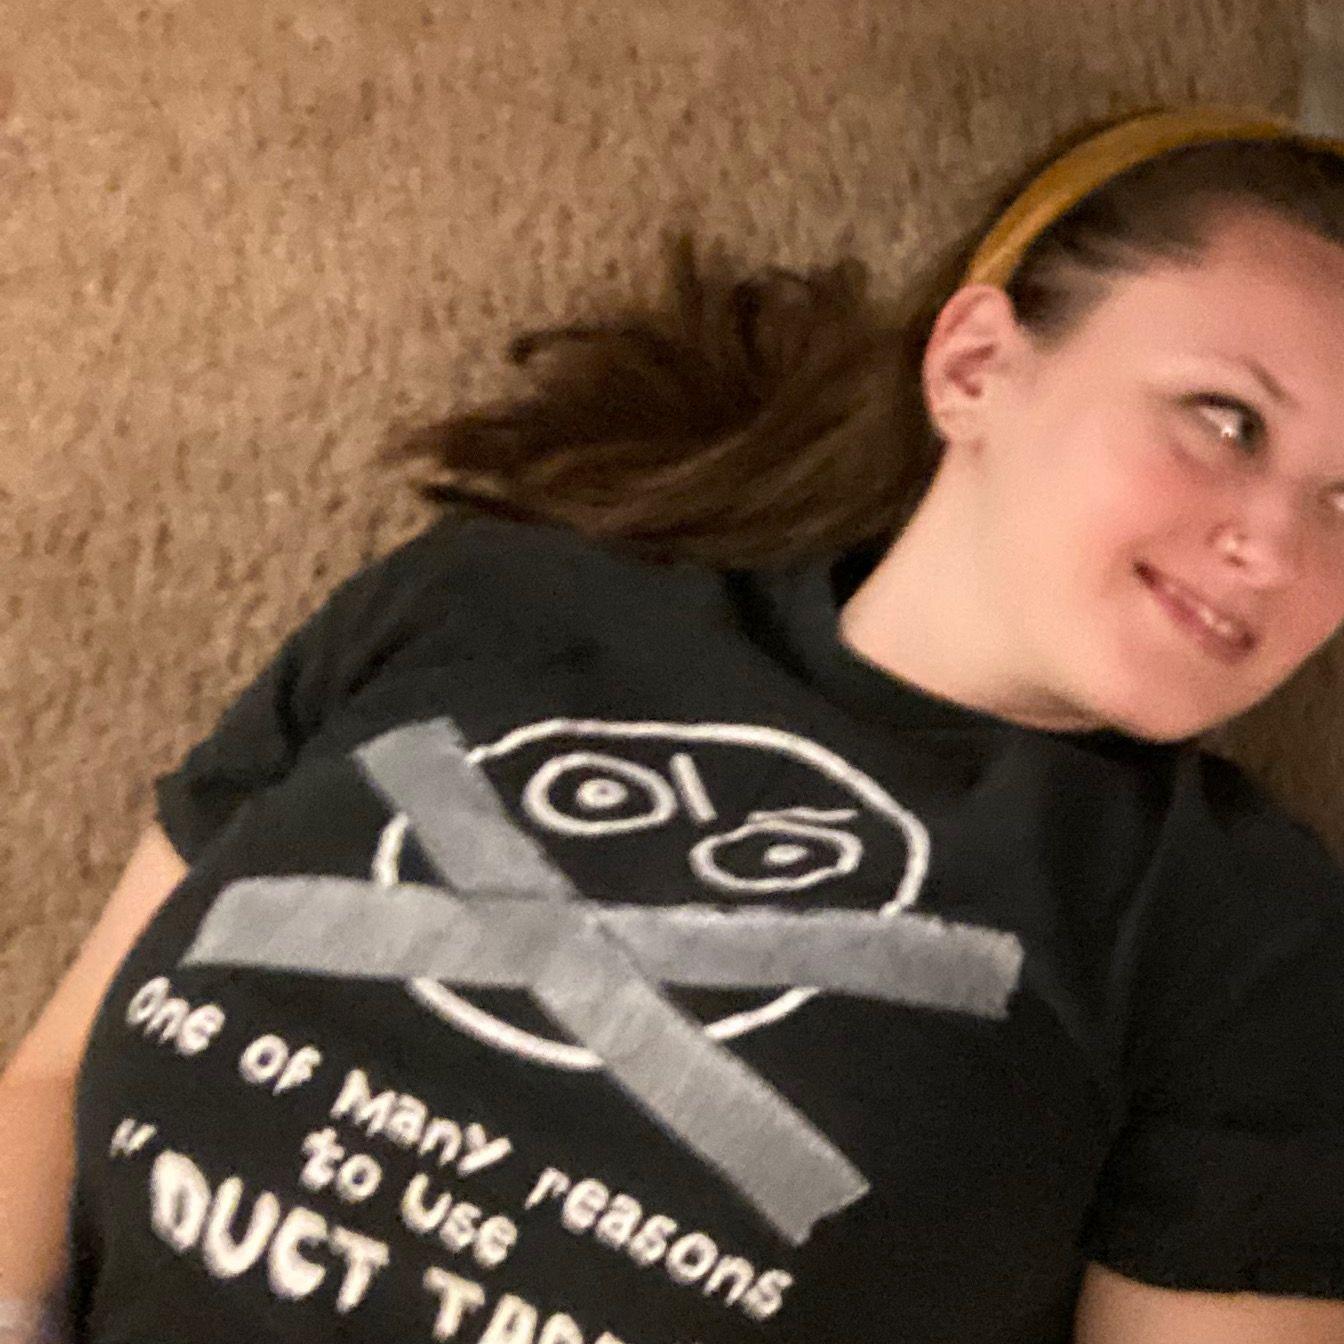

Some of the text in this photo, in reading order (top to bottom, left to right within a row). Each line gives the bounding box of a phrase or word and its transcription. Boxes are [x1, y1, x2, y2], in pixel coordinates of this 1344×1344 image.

[126, 975, 226, 1056] One
[524, 1166, 793, 1319] reasons
[300, 1126, 383, 1202] to
